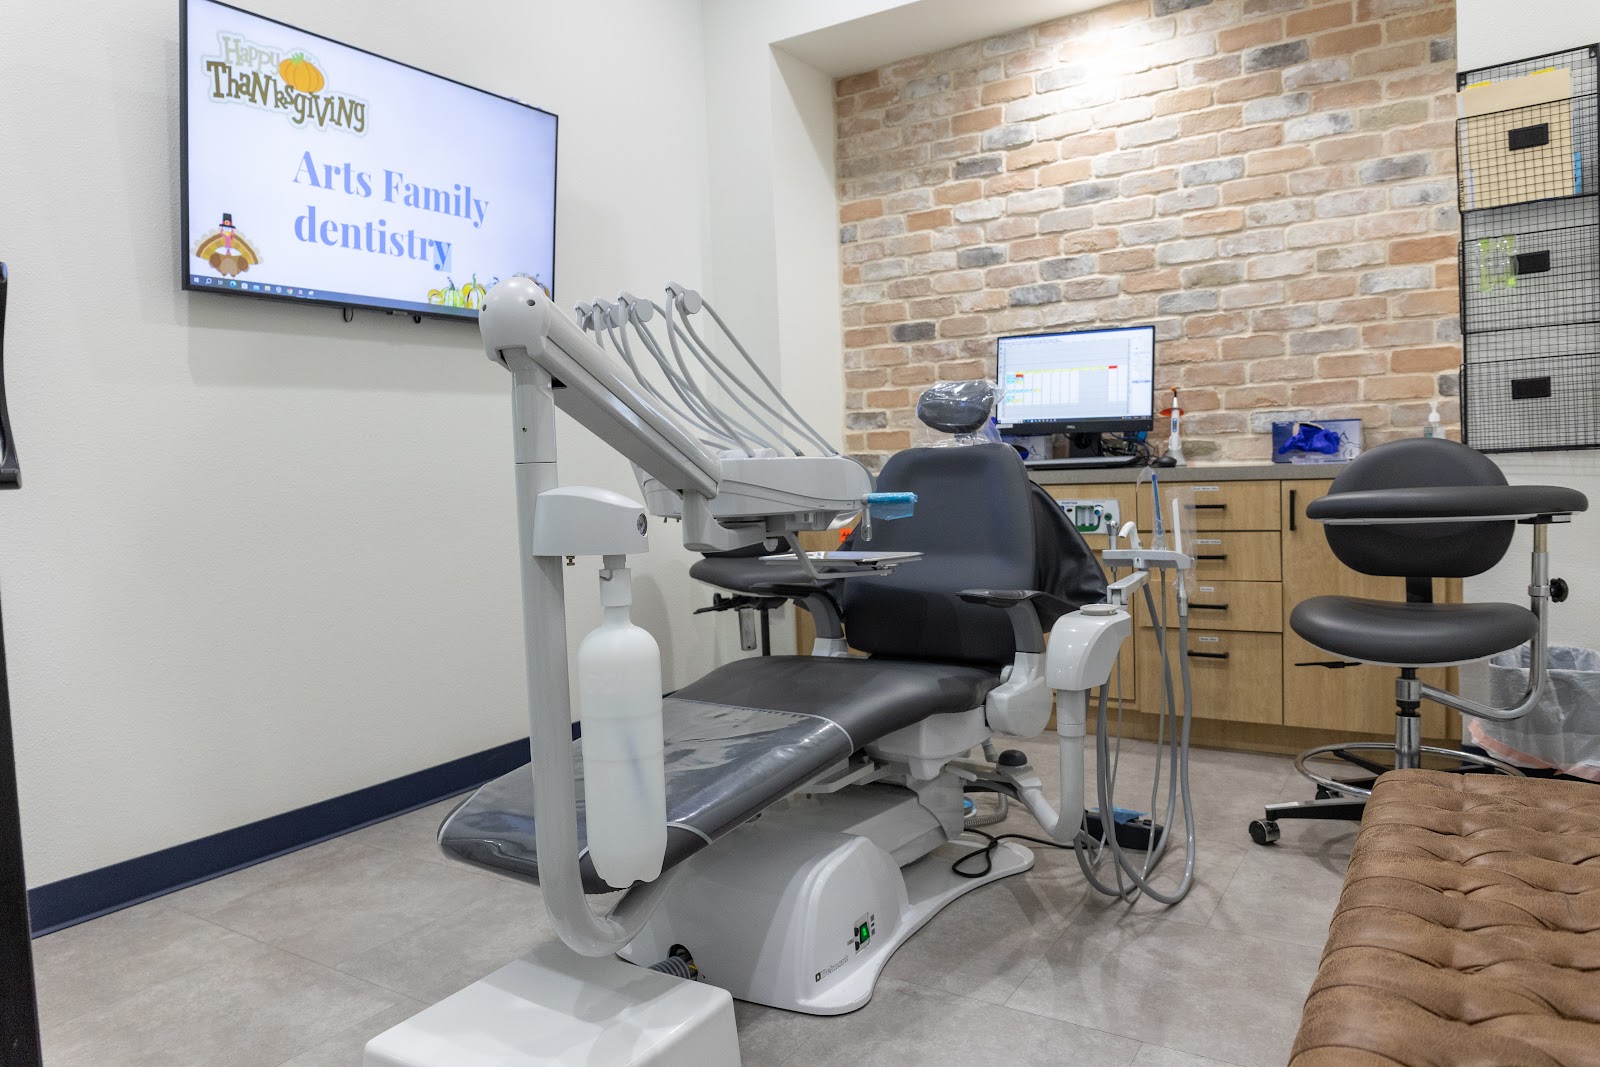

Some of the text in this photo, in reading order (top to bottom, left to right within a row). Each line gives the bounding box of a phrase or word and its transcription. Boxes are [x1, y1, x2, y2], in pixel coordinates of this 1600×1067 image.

[222, 36, 280, 75] Happy
[292, 150, 489, 229] Arts Family
[294, 204, 452, 272] dentistry
